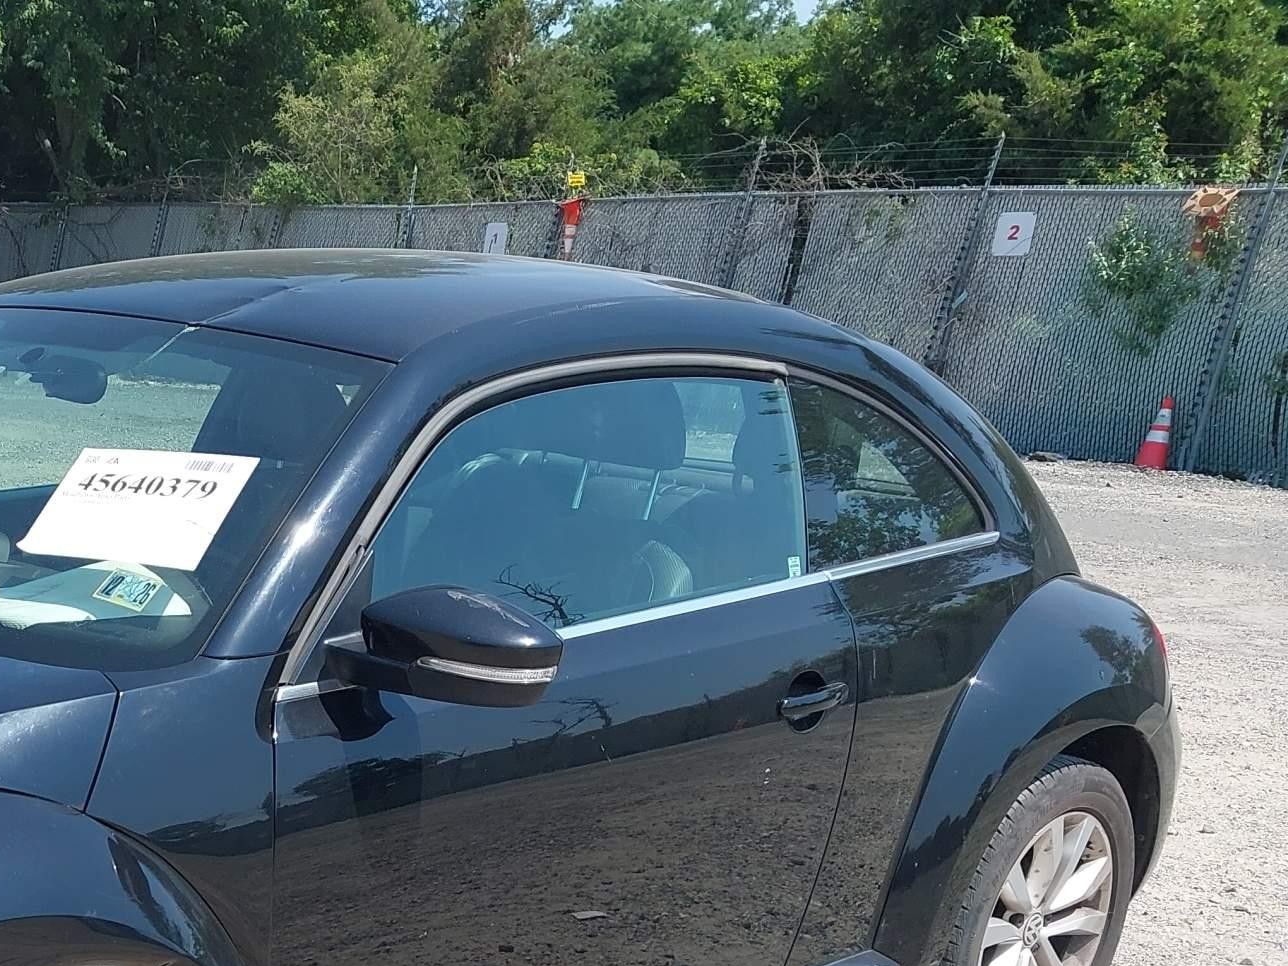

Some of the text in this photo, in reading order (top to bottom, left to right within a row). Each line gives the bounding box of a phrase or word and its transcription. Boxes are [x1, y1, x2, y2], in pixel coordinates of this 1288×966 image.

[1007, 224, 1021, 241] 2
[78, 472, 218, 499] 45640379
[101, 575, 157, 605] 12 26
